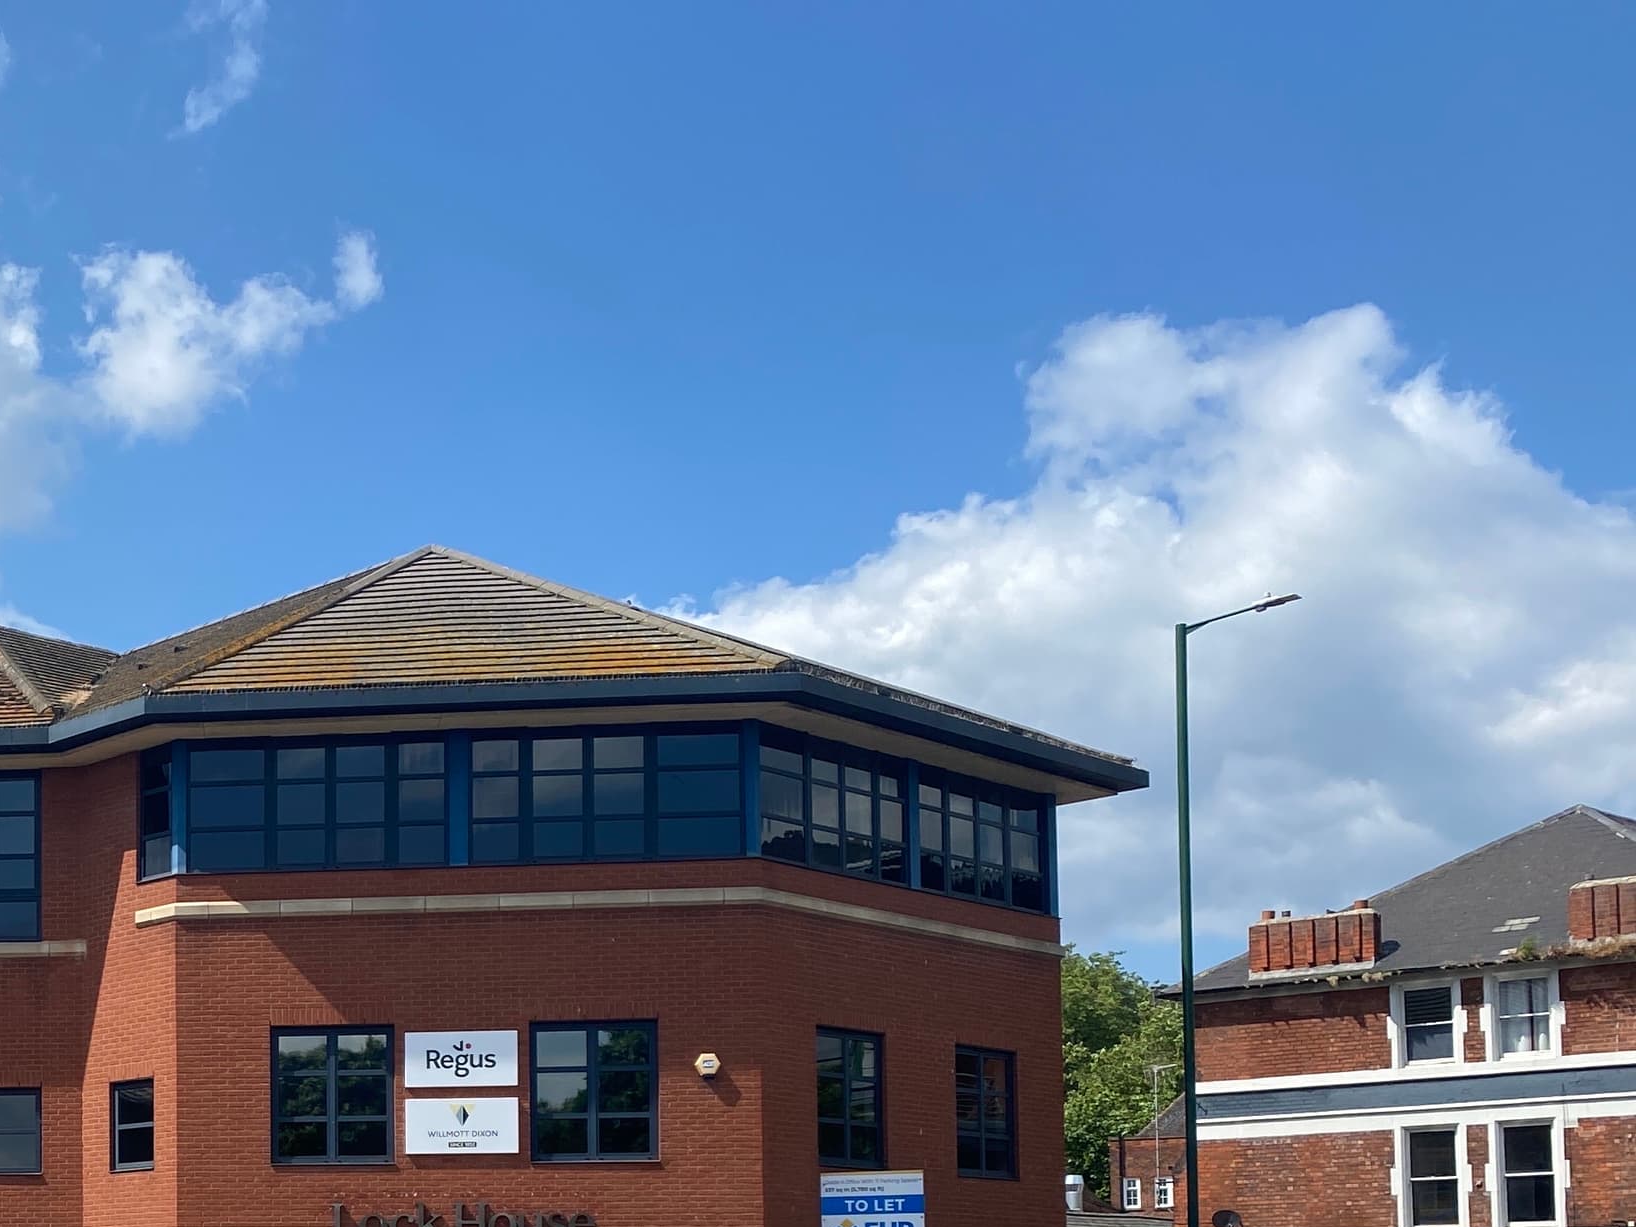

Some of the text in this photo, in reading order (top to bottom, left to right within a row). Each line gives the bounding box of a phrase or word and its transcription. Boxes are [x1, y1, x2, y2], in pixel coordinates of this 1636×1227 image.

[426, 1049, 497, 1078] Regus
[427, 1129, 499, 1138] WILLMOTT DIXON
[844, 1198, 906, 1213] TO LET
